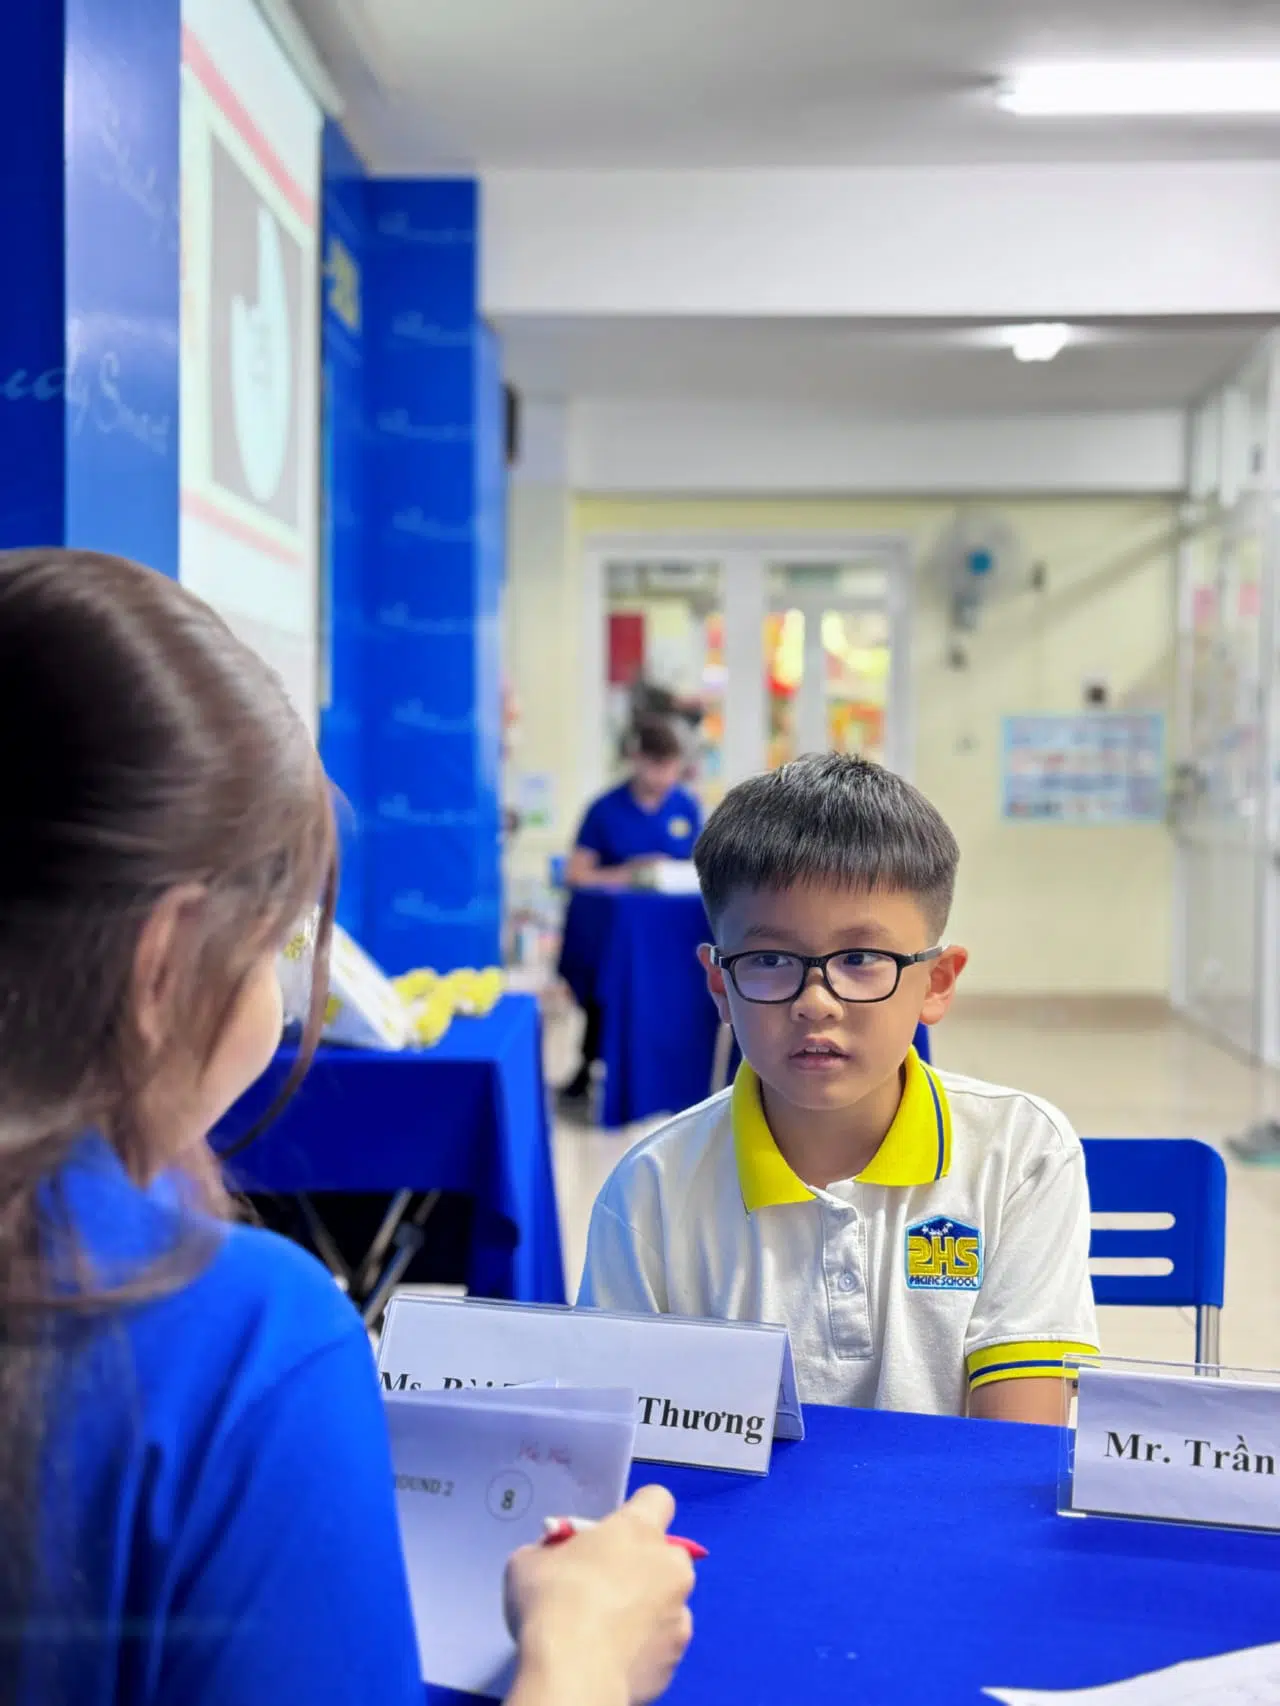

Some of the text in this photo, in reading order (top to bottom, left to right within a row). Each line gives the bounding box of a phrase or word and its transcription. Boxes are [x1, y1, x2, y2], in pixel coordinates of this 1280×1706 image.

[940, 1275, 977, 1287] SCHOOL
[638, 1396, 765, 1445] Thương
[1104, 1431, 1275, 1475] Mr. Trần
[501, 1489, 515, 1511] 8
